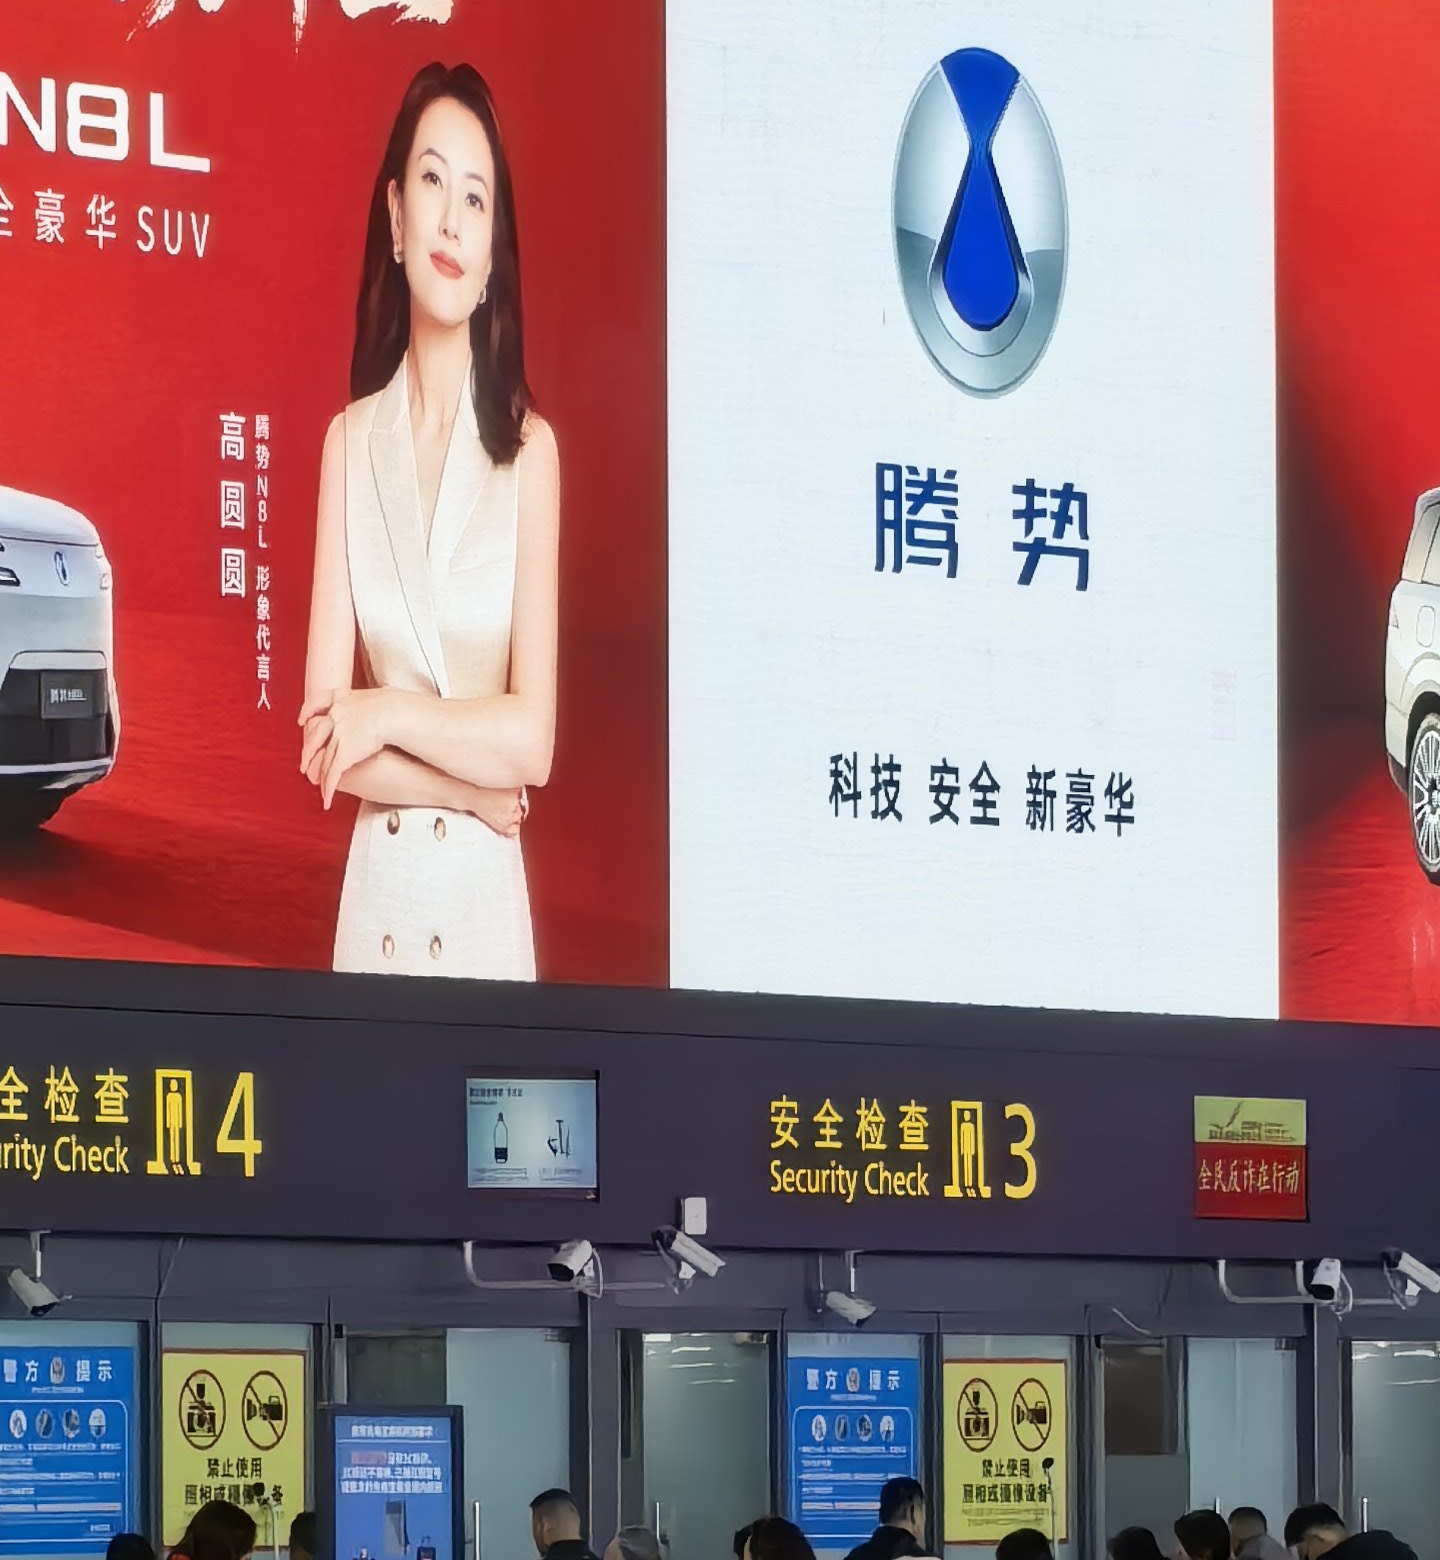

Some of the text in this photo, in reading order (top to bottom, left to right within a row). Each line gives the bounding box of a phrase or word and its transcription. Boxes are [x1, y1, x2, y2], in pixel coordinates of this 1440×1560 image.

[220, 412, 246, 597] 高圆圆
[875, 463, 1089, 591] 腾势
[829, 752, 1134, 836] 科技 安全 新豪华
[54, 1134, 129, 1173] Check
[217, 1072, 262, 1177] 4
[771, 1095, 929, 1151] 安全检查
[1005, 1103, 1036, 1198] 3
[771, 1160, 929, 1203] Security Check
